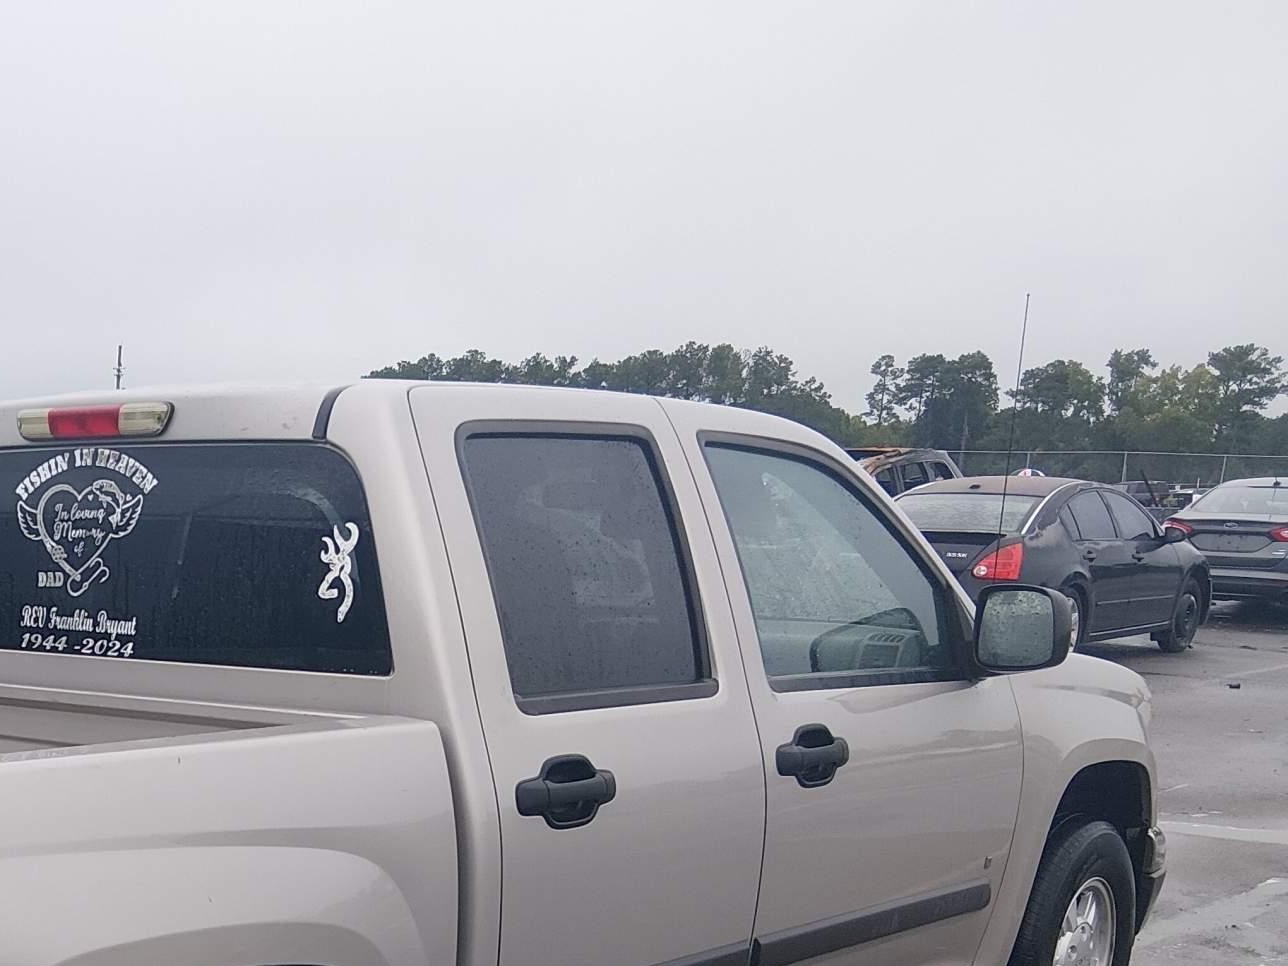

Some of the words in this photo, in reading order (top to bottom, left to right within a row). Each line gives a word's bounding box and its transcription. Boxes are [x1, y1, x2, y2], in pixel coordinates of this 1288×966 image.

[73, 447, 95, 468] IN
[95, 448, 159, 495] HEAVEN
[54, 503, 69, 521] In
[37, 571, 64, 588] DAD
[20, 605, 47, 628] REV
[48, 606, 94, 632] Franklin
[95, 610, 137, 641] Bryant
[21, 632, 68, 651] 1944
